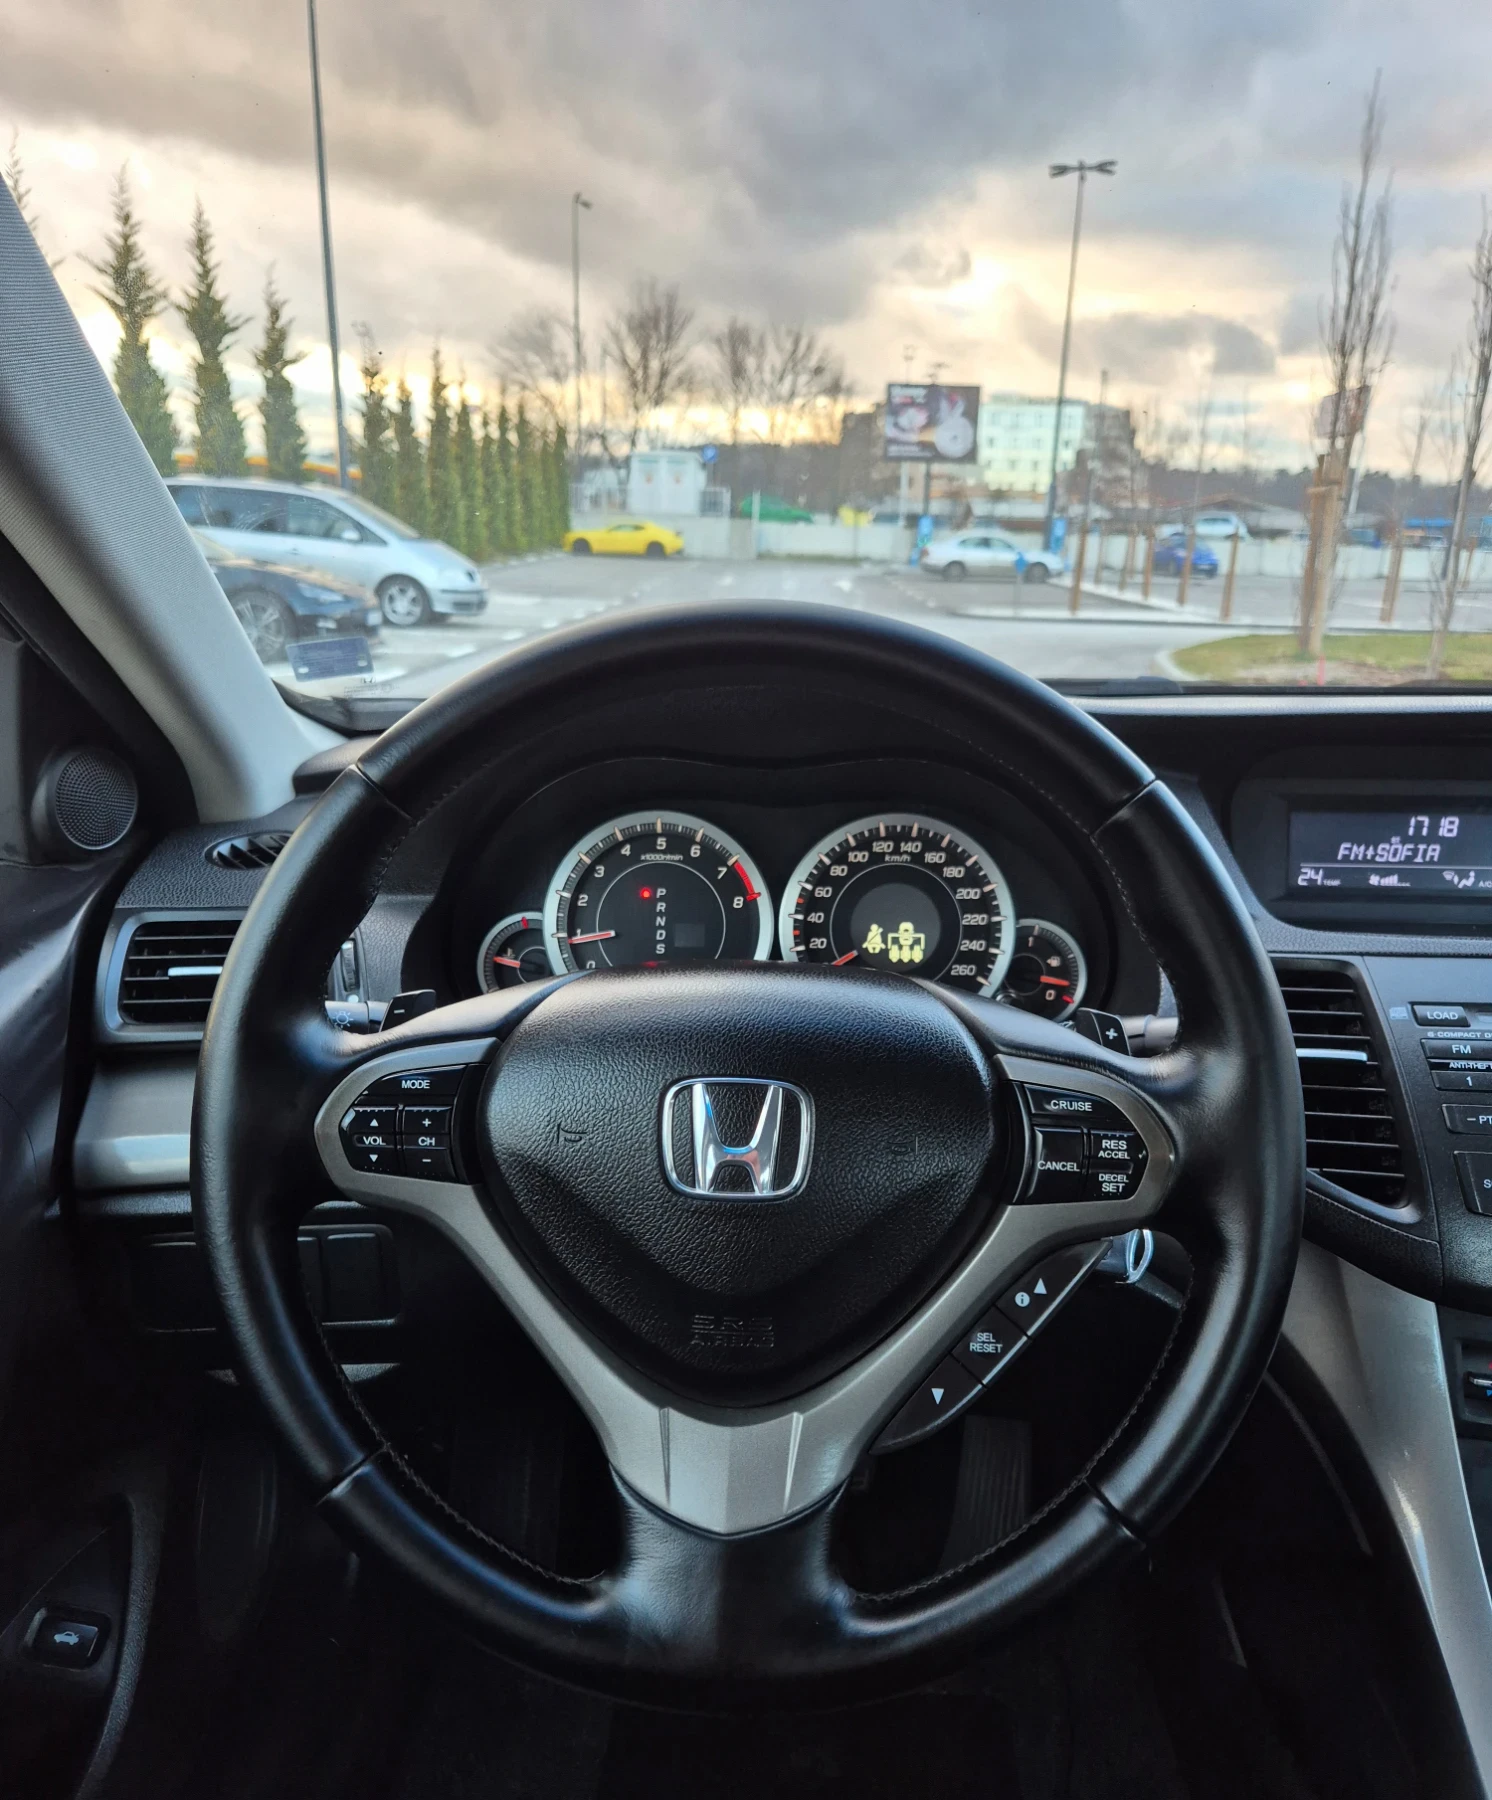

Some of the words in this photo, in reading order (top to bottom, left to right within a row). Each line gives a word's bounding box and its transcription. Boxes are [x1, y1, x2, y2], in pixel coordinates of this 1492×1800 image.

[656, 837, 667, 850] 5
[872, 841, 894, 852] 120
[900, 841, 922, 853] 140
[620, 844, 631, 857] 4
[690, 844, 701, 857] 6
[848, 851, 869, 863] 100
[884, 854, 911, 863] km/h
[924, 852, 946, 864] 160
[594, 866, 605, 878] 3
[717, 867, 728, 880] 7
[830, 865, 848, 877] 80
[943, 867, 965, 878] 180
[1297, 867, 1323, 886] 24
[656, 888, 666, 898] P
[814, 887, 832, 898] 60
[955, 888, 981, 900] 200
[577, 894, 588, 906] 2
[733, 896, 744, 908] 8
[656, 902, 666, 912] R
[656, 916, 666, 926] N
[807, 912, 824, 924] 40
[962, 914, 988, 925] 220
[656, 930, 666, 940] D
[655, 944, 666, 954] S
[809, 938, 827, 949] 20
[960, 940, 985, 951] 240
[950, 965, 976, 976] 260
[1044, 989, 1057, 1001] 0
[1427, 1011, 1459, 1020] LOAD
[1451, 1044, 1472, 1054] FM
[401, 1080, 431, 1089] MODE
[1465, 1076, 1473, 1087] 1
[1050, 1100, 1093, 1112] CRUISE
[363, 1136, 386, 1146] VOL
[418, 1137, 436, 1147] CH
[1102, 1140, 1128, 1150] RES
[1098, 1151, 1131, 1160] ACCEL
[1037, 1160, 1080, 1172] CANCEL
[1098, 1173, 1129, 1183] DECEL
[1101, 1183, 1125, 1193] SET
[976, 1332, 996, 1343] SEL
[969, 1342, 1003, 1354] RESET
